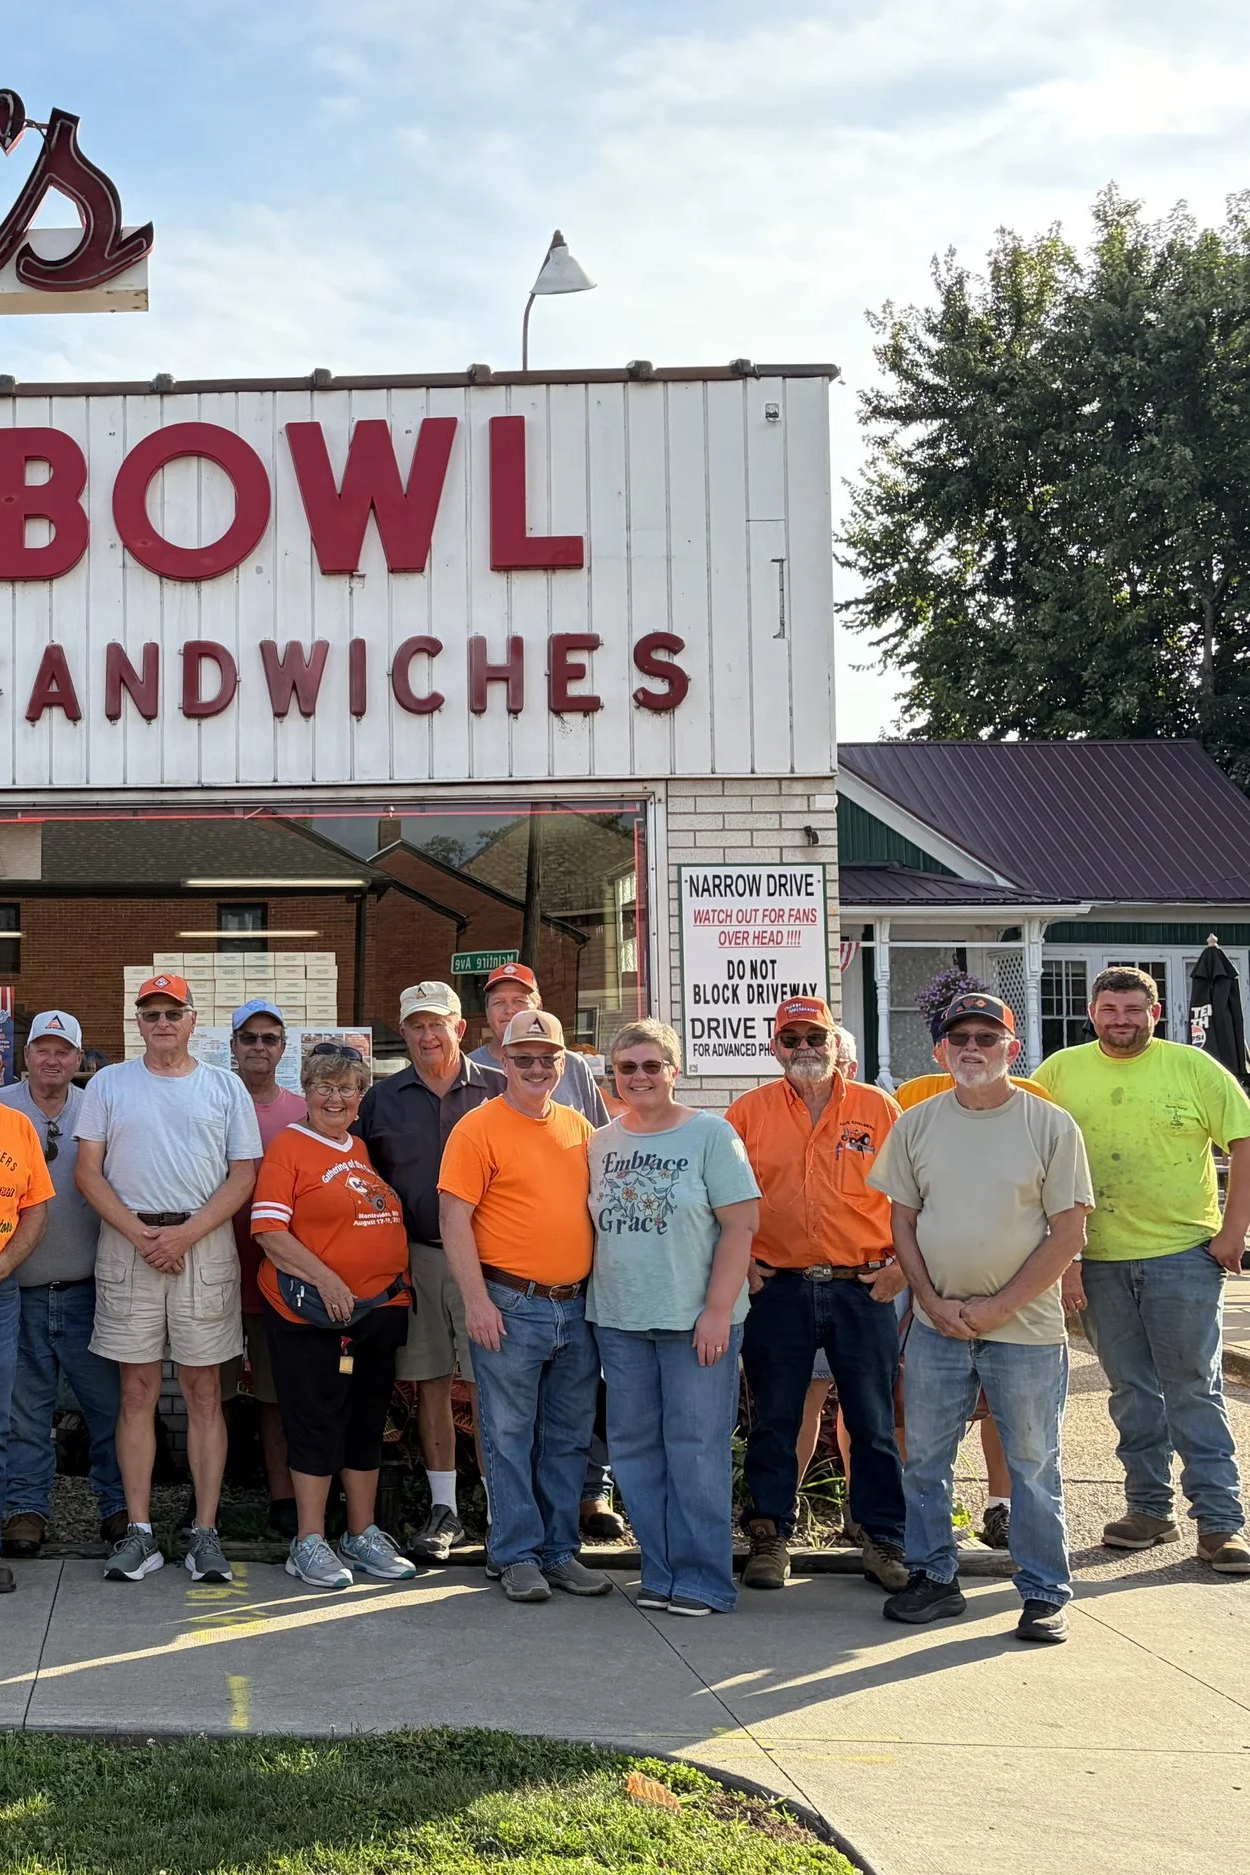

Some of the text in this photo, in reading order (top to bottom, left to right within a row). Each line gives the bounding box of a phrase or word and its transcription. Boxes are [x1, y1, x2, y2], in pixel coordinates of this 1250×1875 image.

[689, 873, 815, 897] NARROW DRIVE
[693, 908, 817, 924] WATCH OUT FOR FANS
[718, 930, 801, 945] OVER HEAD !!!!
[727, 959, 777, 980] DO NOT
[693, 983, 818, 1005] BLOCK DRIVEWAY
[690, 1017, 756, 1040] DRIVE
[693, 1043, 711, 1057] FOR
[712, 1043, 757, 1057] ADVANCED
[602, 1150, 689, 1172] Embrace
[598, 1207, 668, 1235] Grace
